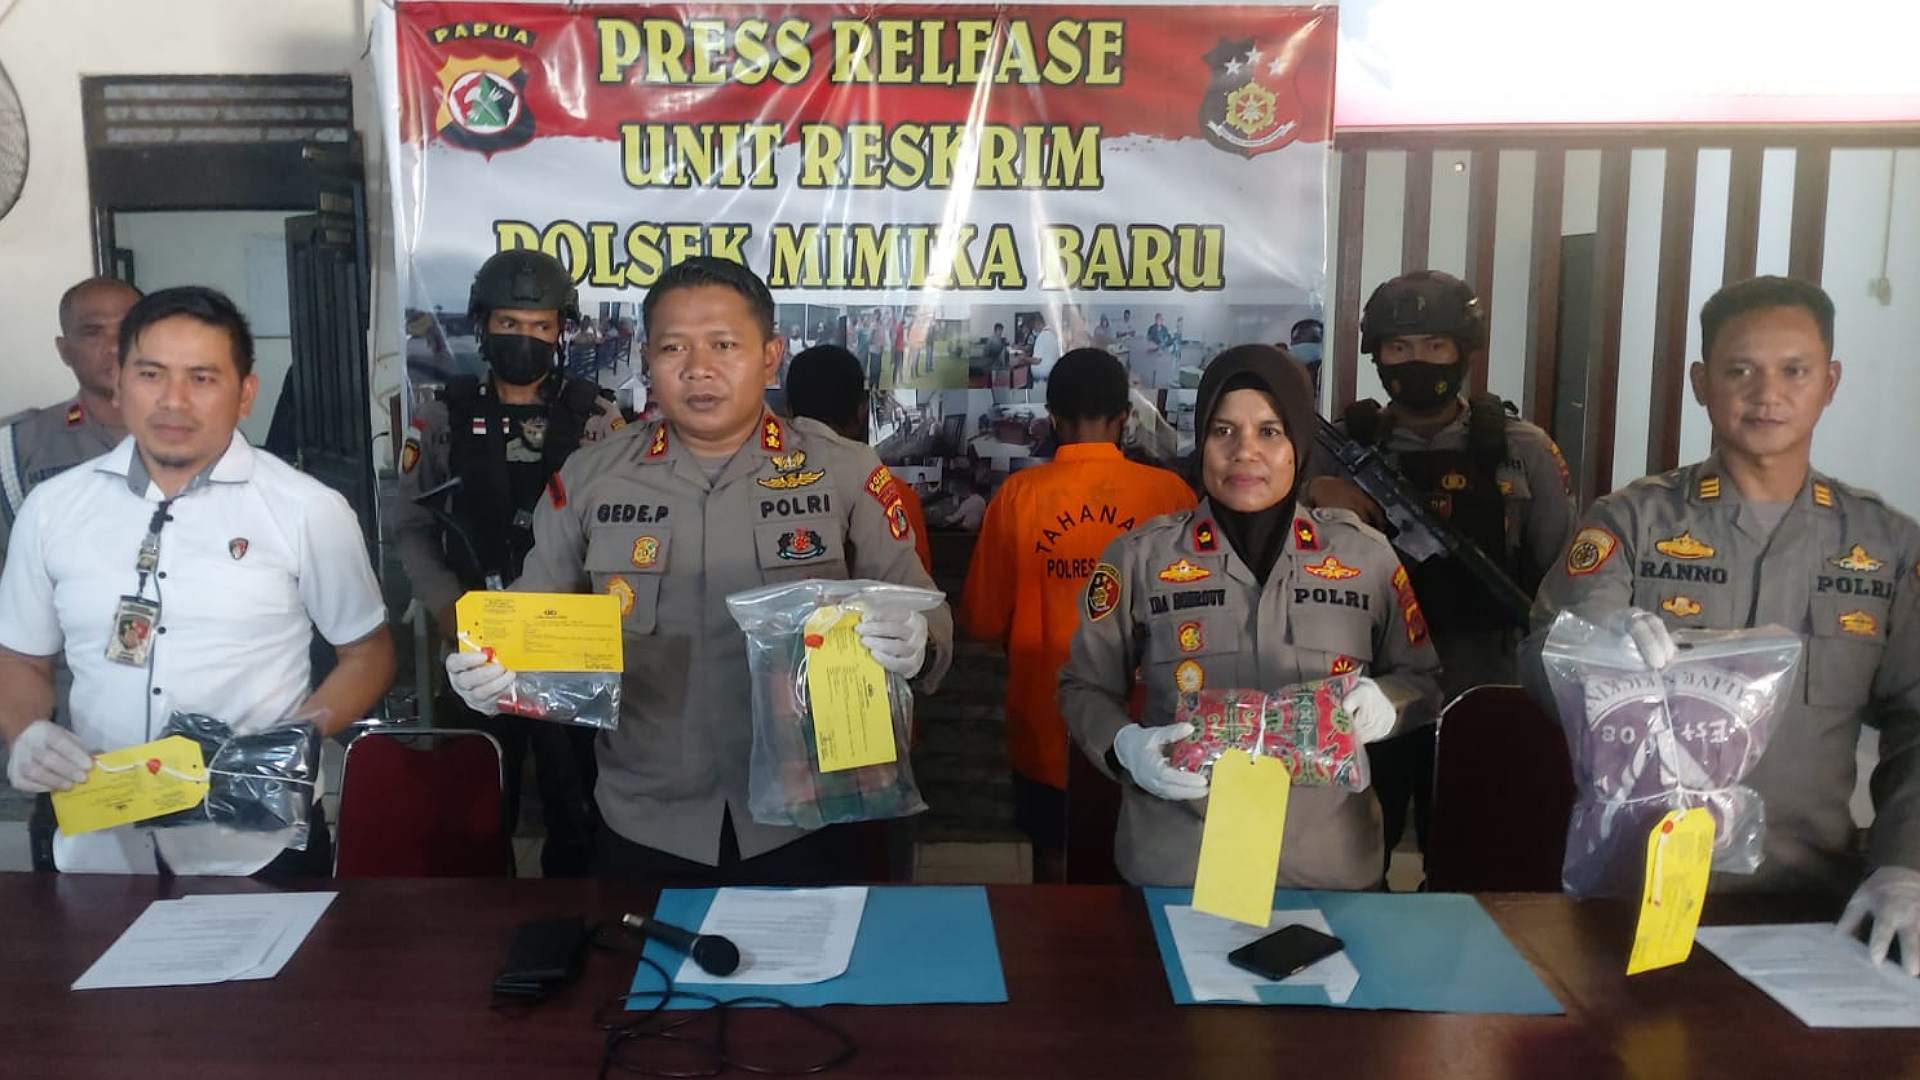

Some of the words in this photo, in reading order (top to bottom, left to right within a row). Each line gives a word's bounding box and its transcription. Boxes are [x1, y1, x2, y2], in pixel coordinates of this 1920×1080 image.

[434, 22, 528, 45] PAPUA
[596, 17, 812, 85] PRESS
[830, 18, 1124, 86] RELEASE
[619, 121, 784, 189] UNIT
[800, 122, 1103, 191] RESKRIM
[769, 222, 1026, 291] MIMIKA
[1040, 222, 1226, 291] BARU
[760, 493, 831, 519] POLRI
[1640, 561, 1728, 584] RANNO
[1294, 588, 1369, 610] POLRI
[1817, 575, 1893, 599] POLRI
